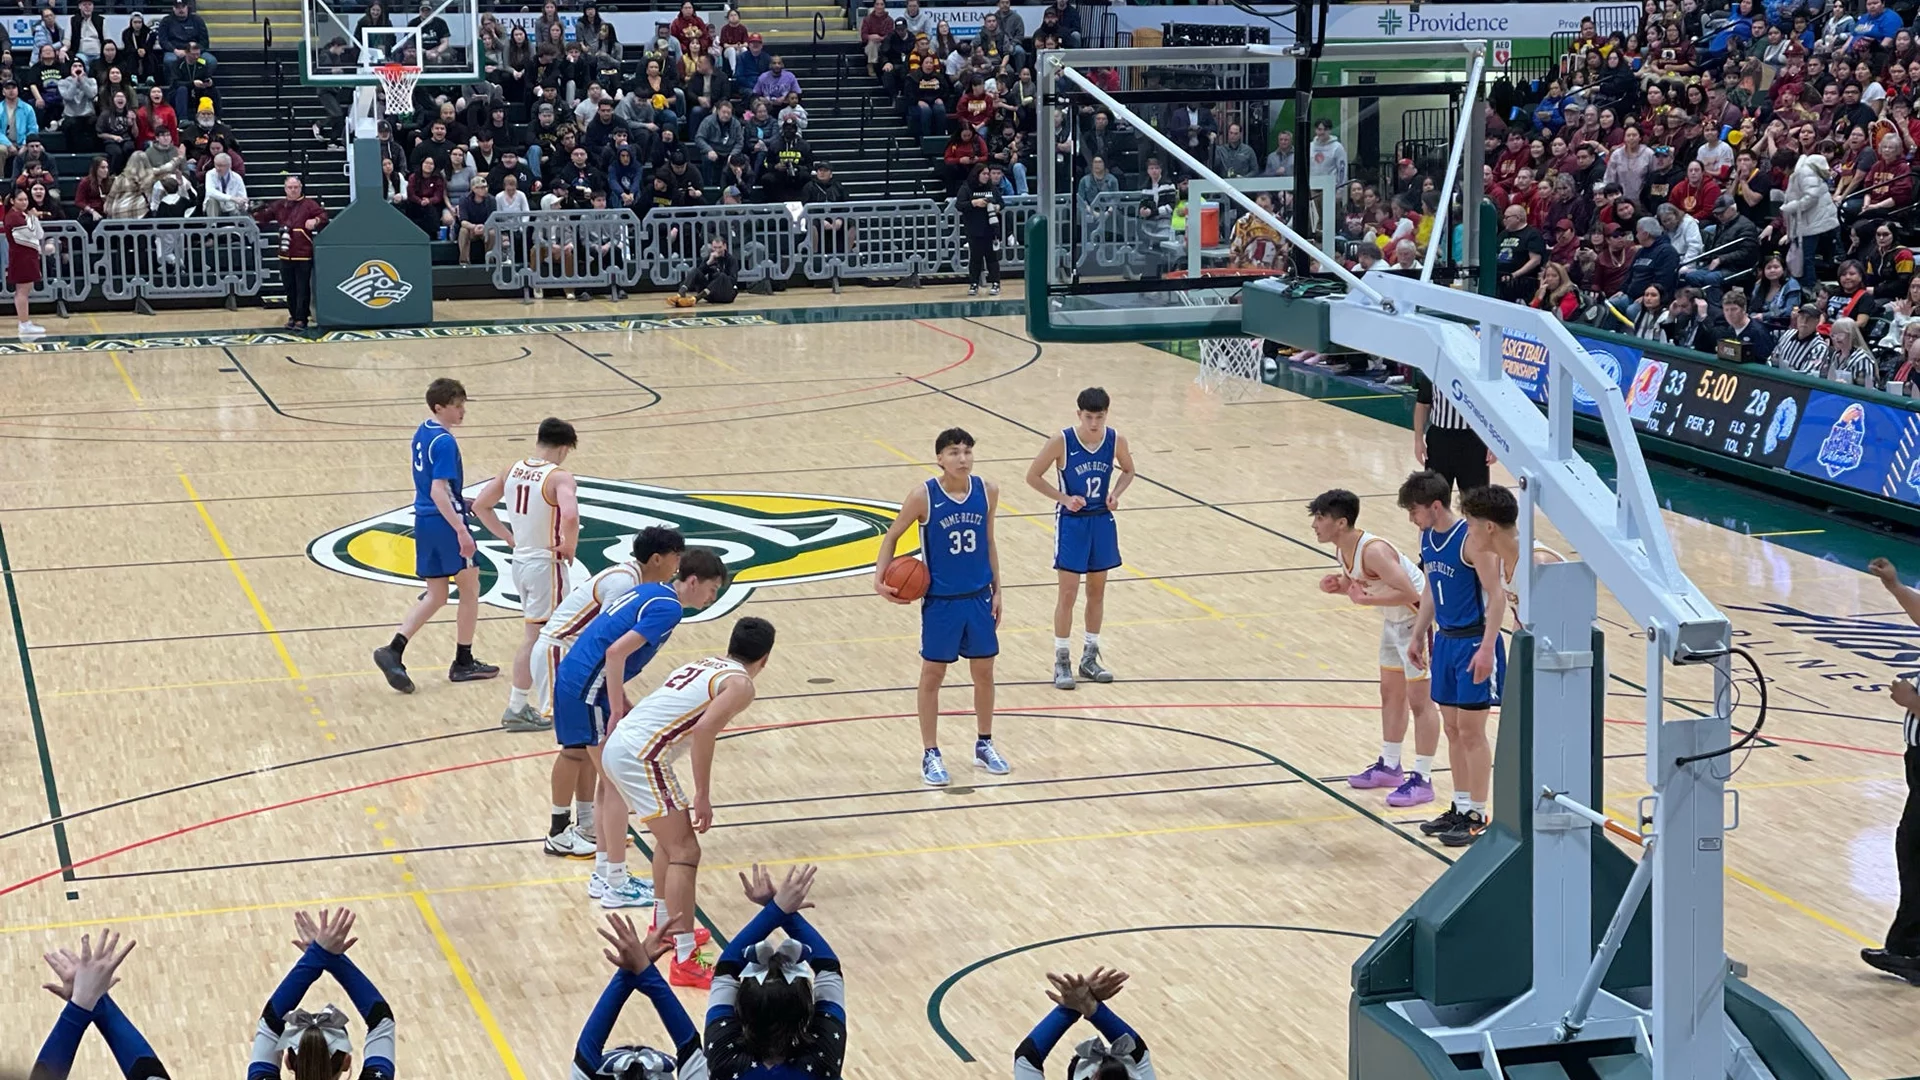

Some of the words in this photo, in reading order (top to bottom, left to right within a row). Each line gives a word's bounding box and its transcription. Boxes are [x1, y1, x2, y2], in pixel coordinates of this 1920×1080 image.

[1408, 12, 1508, 32] Providence
[1495, 41, 1510, 49] AED
[318, 314, 777, 342] ANCHORAGE
[1503, 337, 1548, 365] ASKETBALL
[1664, 369, 1687, 396] 33
[1696, 369, 1738, 404] 5:00
[1744, 388, 1770, 416] 28
[1652, 401, 1667, 414] FLS
[1676, 403, 1683, 418] 1
[1646, 417, 1660, 431] TOL
[1666, 421, 1676, 436] 4
[1685, 414, 1705, 431] PER
[1705, 419, 1716, 437] 3
[1728, 420, 1746, 435] FLS
[1751, 423, 1761, 438] 2
[413, 441, 424, 472] 3
[1724, 438, 1739, 453] TOL
[1744, 442, 1754, 458] 3
[511, 467, 544, 483] BRAVES
[1074, 461, 1110, 475] NOME-BELTZ
[1085, 477, 1102, 498] 12
[515, 484, 531, 515] 11
[939, 511, 983, 529] NOME-BELTZ
[949, 529, 977, 554] 33
[1437, 579, 1444, 606] 1
[664, 666, 705, 691] 21
